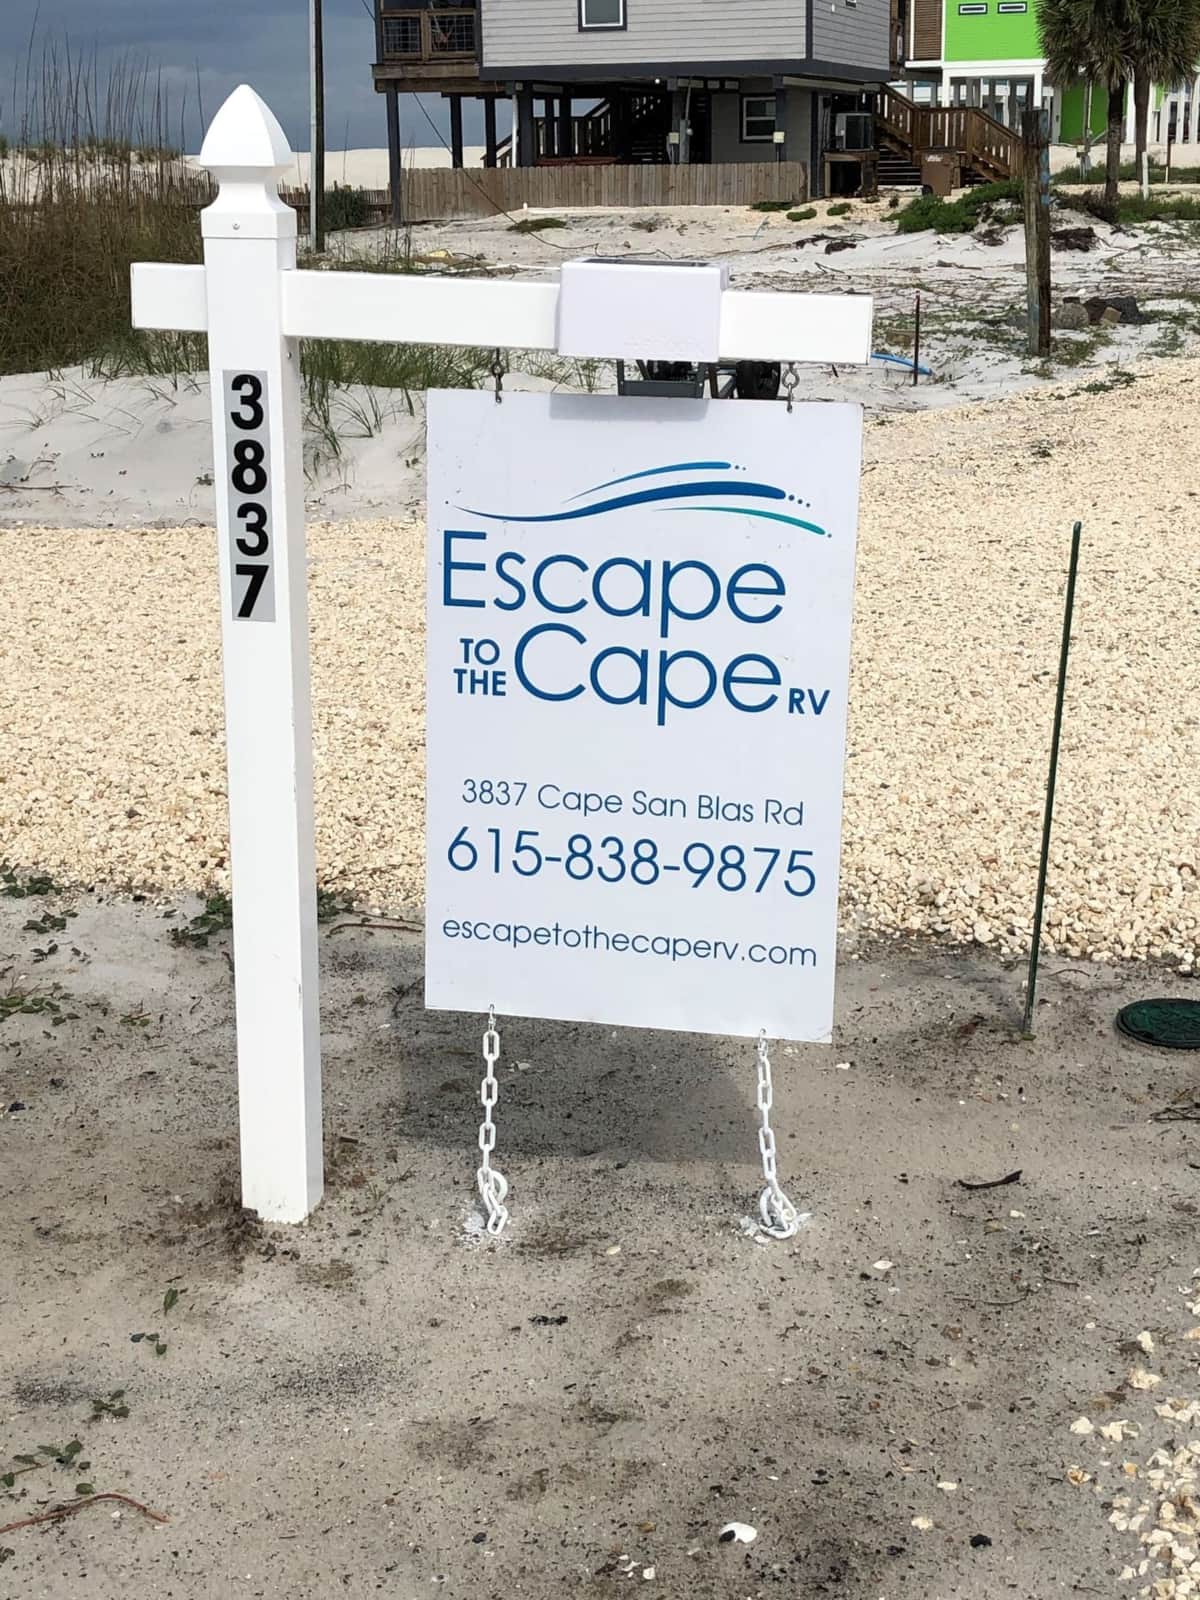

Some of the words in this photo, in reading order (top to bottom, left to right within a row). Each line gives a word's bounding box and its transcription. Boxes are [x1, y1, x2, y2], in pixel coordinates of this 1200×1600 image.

[230, 374, 269, 618] 3837
[443, 530, 786, 638] Escape
[460, 638, 500, 665] TO
[514, 622, 782, 726] Cape
[788, 687, 830, 715] RV
[453, 668, 506, 696] THE
[461, 778, 527, 807] 3837
[537, 783, 623, 817] Cape
[631, 790, 687, 818] San
[697, 795, 754, 824] Blas
[764, 799, 804, 826] Rd
[447, 826, 816, 897] 615-838-9875
[442, 918, 817, 967] escapetothecaperv.com
